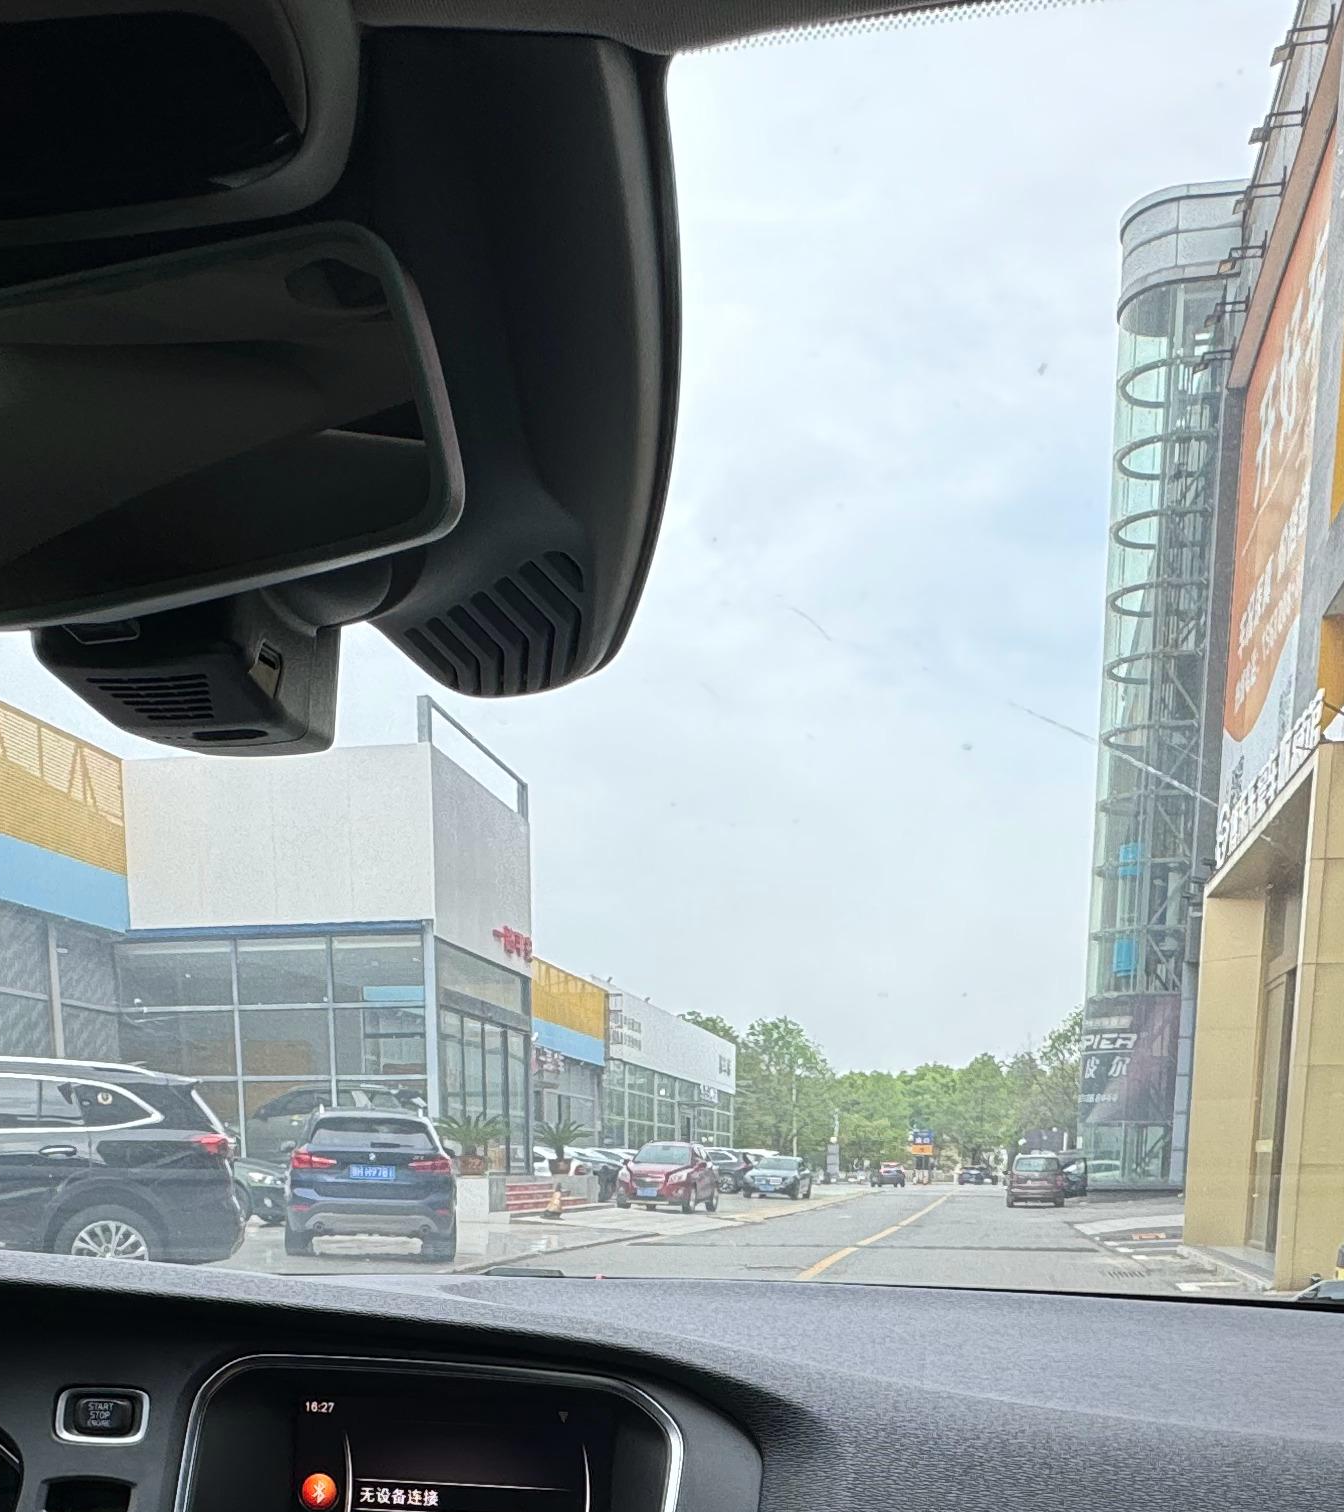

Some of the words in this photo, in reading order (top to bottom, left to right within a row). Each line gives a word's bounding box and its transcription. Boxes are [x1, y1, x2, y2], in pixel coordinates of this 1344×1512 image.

[88, 1402, 114, 1411] START
[305, 1401, 335, 1413] 16:27
[90, 1411, 111, 1419] STOP
[359, 1487, 439, 1507] 无设备连接
